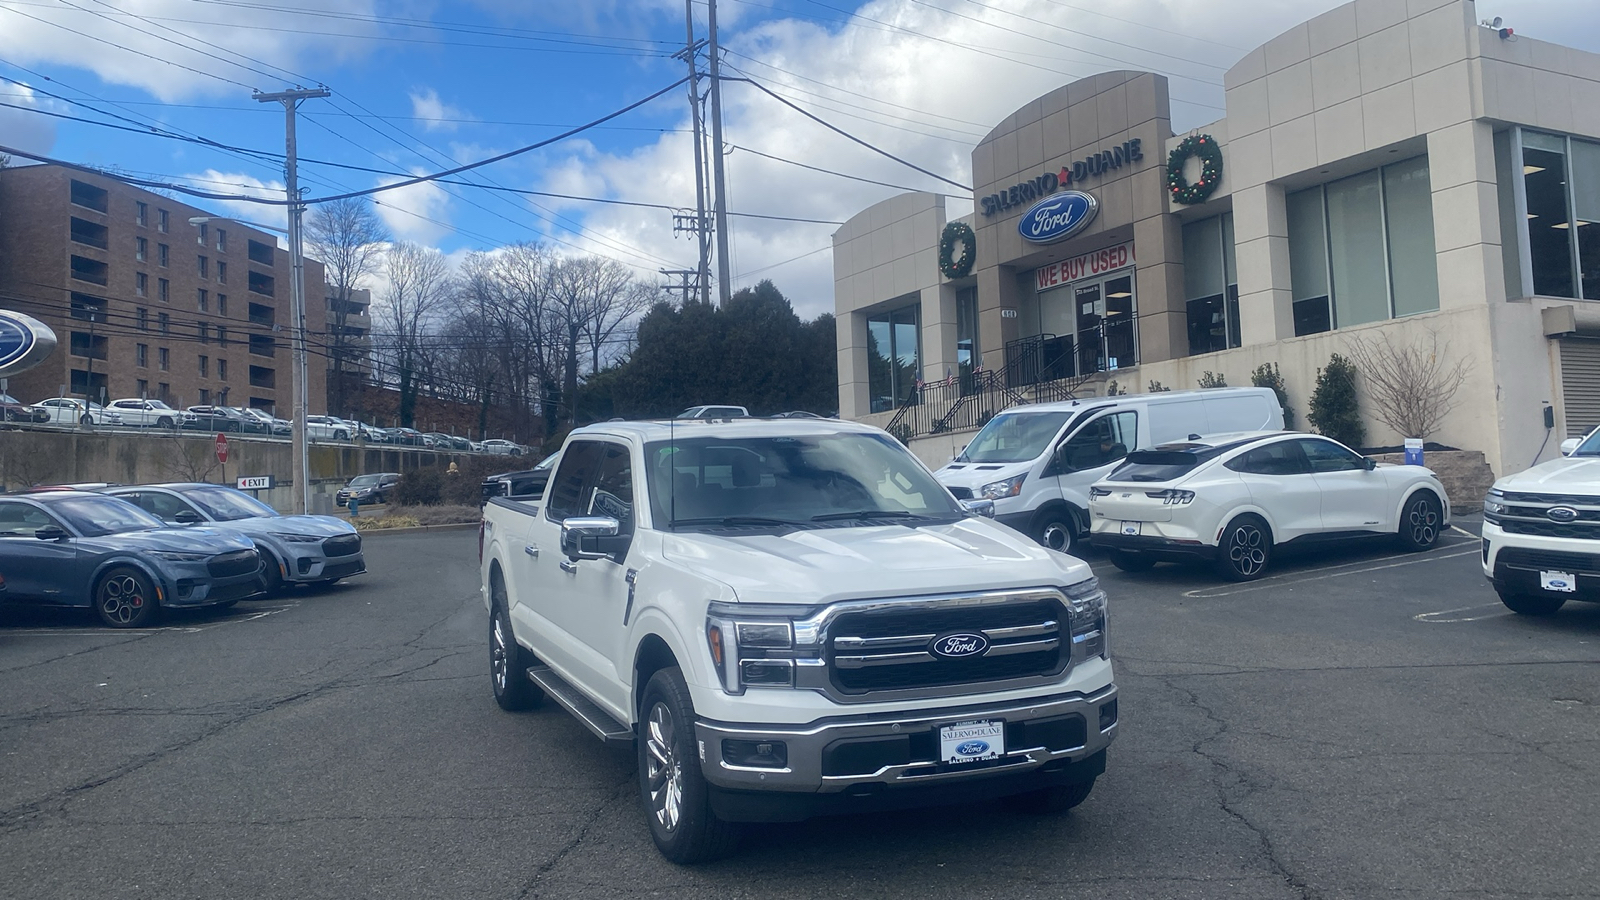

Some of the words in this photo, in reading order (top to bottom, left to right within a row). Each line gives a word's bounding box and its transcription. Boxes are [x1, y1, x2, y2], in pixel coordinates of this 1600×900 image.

[980, 172, 1058, 217] SALERNO
[1072, 138, 1144, 182] DUANE
[1031, 202, 1073, 235] Ford
[1037, 265, 1058, 288] WE
[1061, 256, 1087, 282] BUY
[1090, 245, 1127, 274] USED
[216, 442, 227, 454] STOP
[248, 478, 266, 487] EXIT
[944, 637, 976, 653] Ford
[942, 730, 974, 740] SALERNO
[977, 727, 1001, 736] DUANE
[962, 743, 983, 753] Ford
[948, 757, 974, 765] SALERNO
